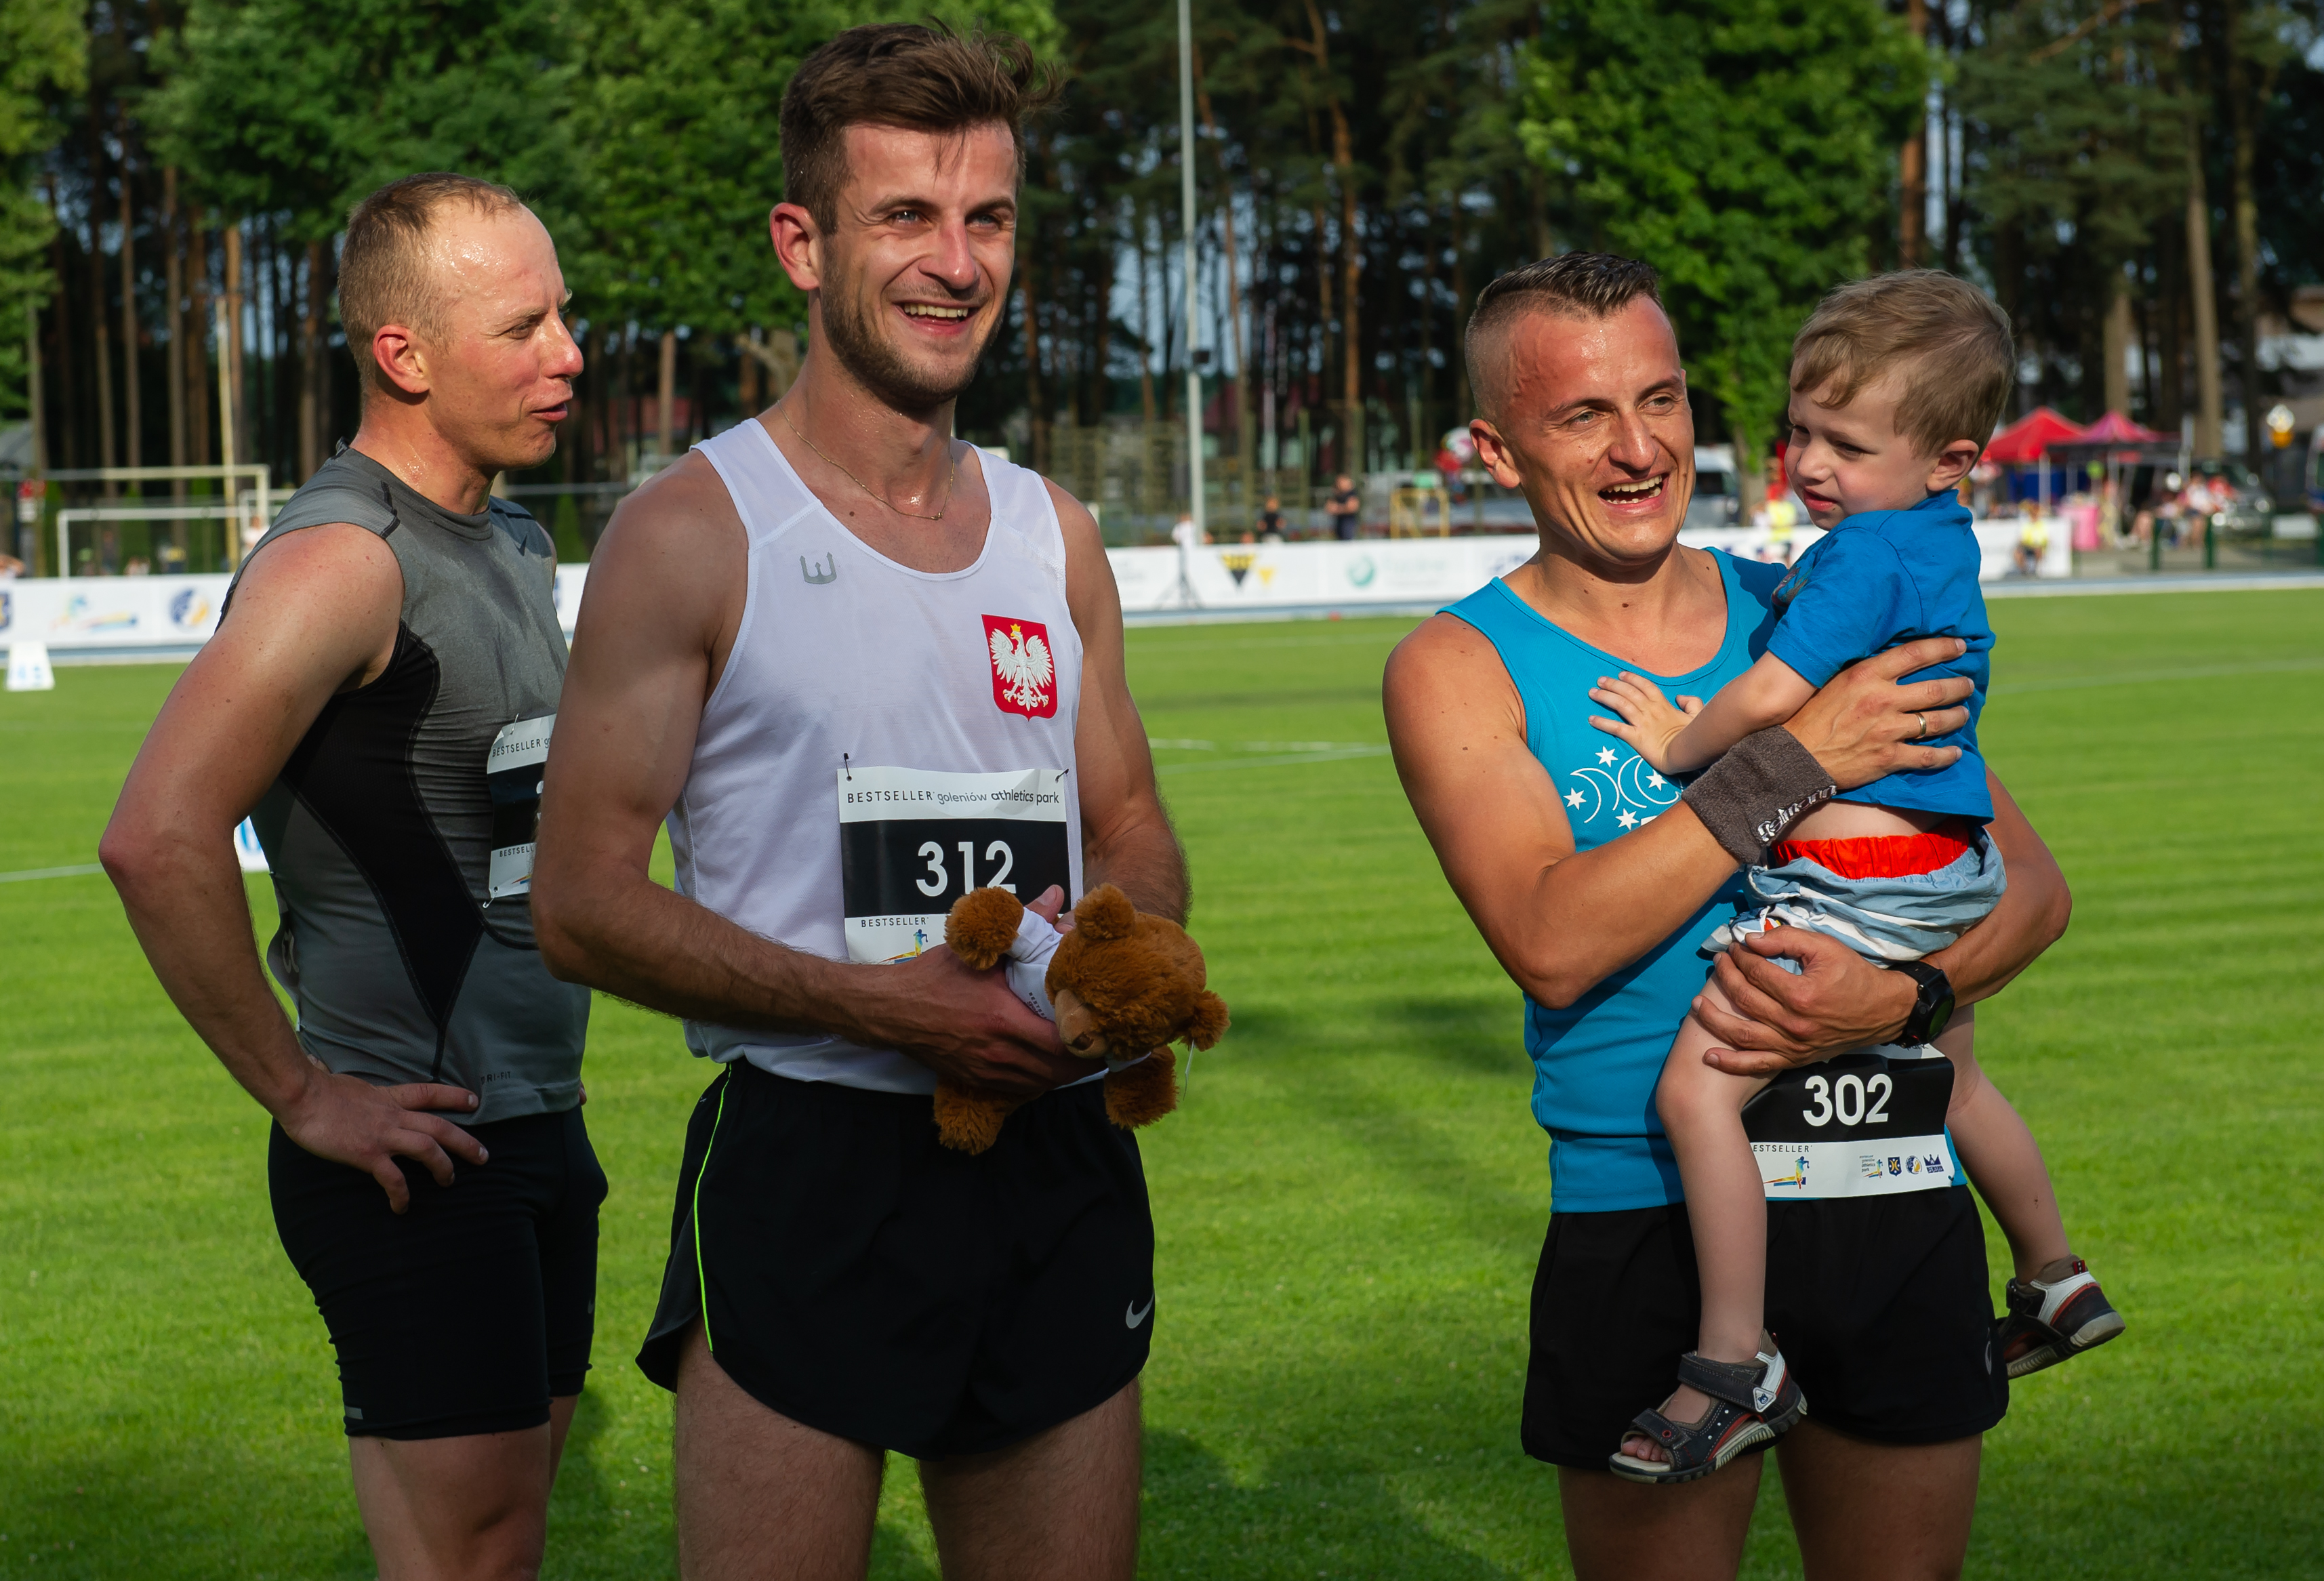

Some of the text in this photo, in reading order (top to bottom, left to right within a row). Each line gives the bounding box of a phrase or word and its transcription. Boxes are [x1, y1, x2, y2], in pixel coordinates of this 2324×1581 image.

[492, 738, 542, 758] BESTSELLER
[847, 789, 1059, 806] BESTSELLER goleniów athletics park
[916, 840, 1017, 897] 312
[861, 917, 926, 928] BESTSELLER
[481, 1071, 511, 1085] DRI-FIT
[1802, 1073, 1893, 1127] 302
